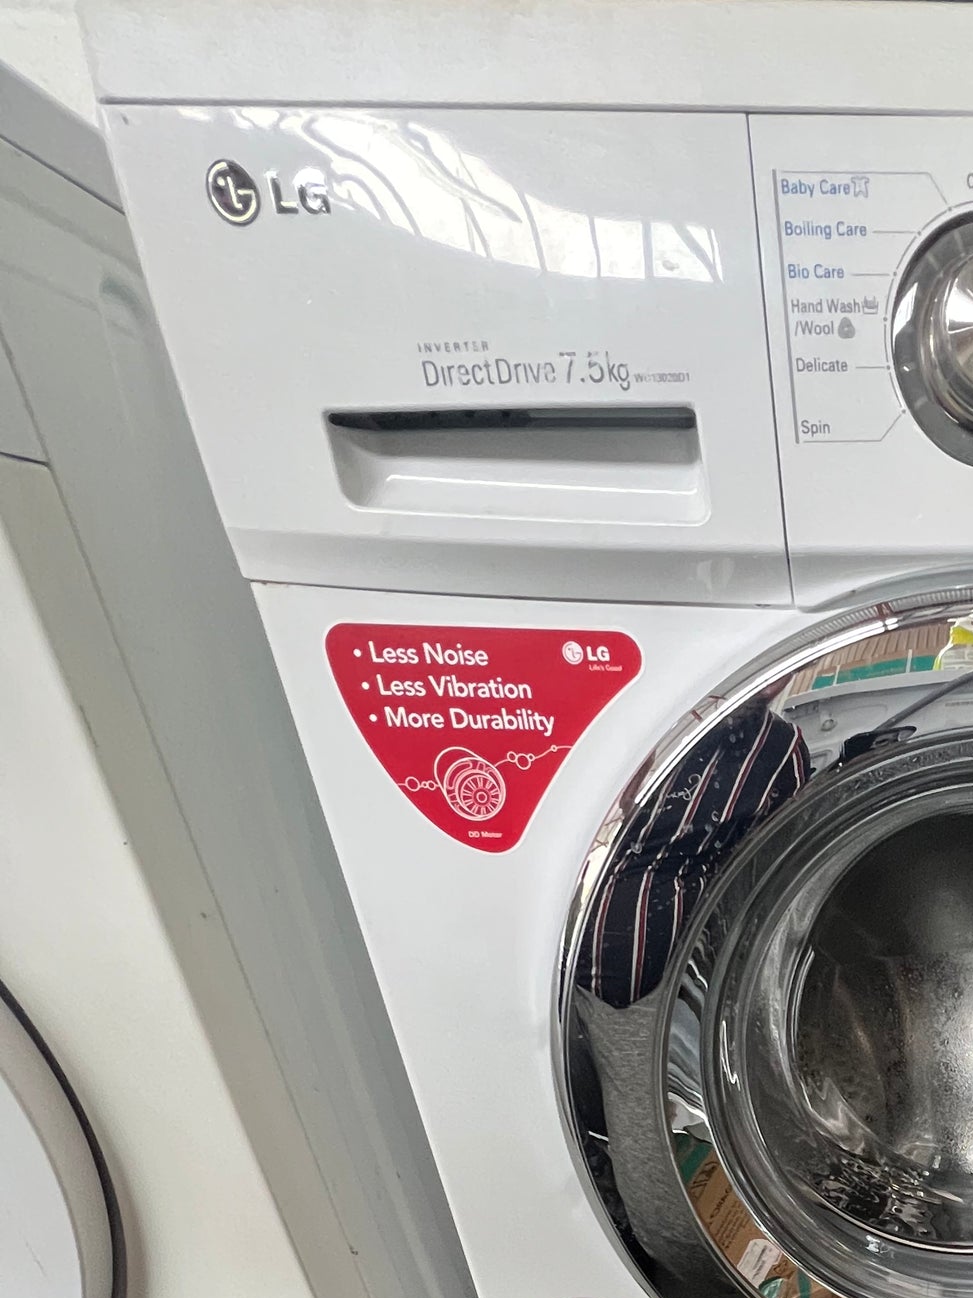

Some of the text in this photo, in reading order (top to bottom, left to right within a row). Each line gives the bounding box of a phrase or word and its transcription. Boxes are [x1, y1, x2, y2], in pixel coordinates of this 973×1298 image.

[264, 166, 331, 215] LG
[781, 179, 850, 197] Baby Care
[784, 221, 867, 239] Boiling Care
[788, 264, 844, 279] Bio Care
[791, 299, 861, 313] Hand Wash
[794, 320, 834, 336] /Wool
[417, 341, 489, 353] INVERTER
[559, 350, 630, 391] 7.5kg
[796, 358, 848, 372] Delicate
[801, 420, 831, 437] Spin
[368, 641, 489, 666] Less Noise
[586, 646, 610, 662] LG
[376, 674, 533, 700] Less Vibration
[384, 706, 555, 737] More Durability
